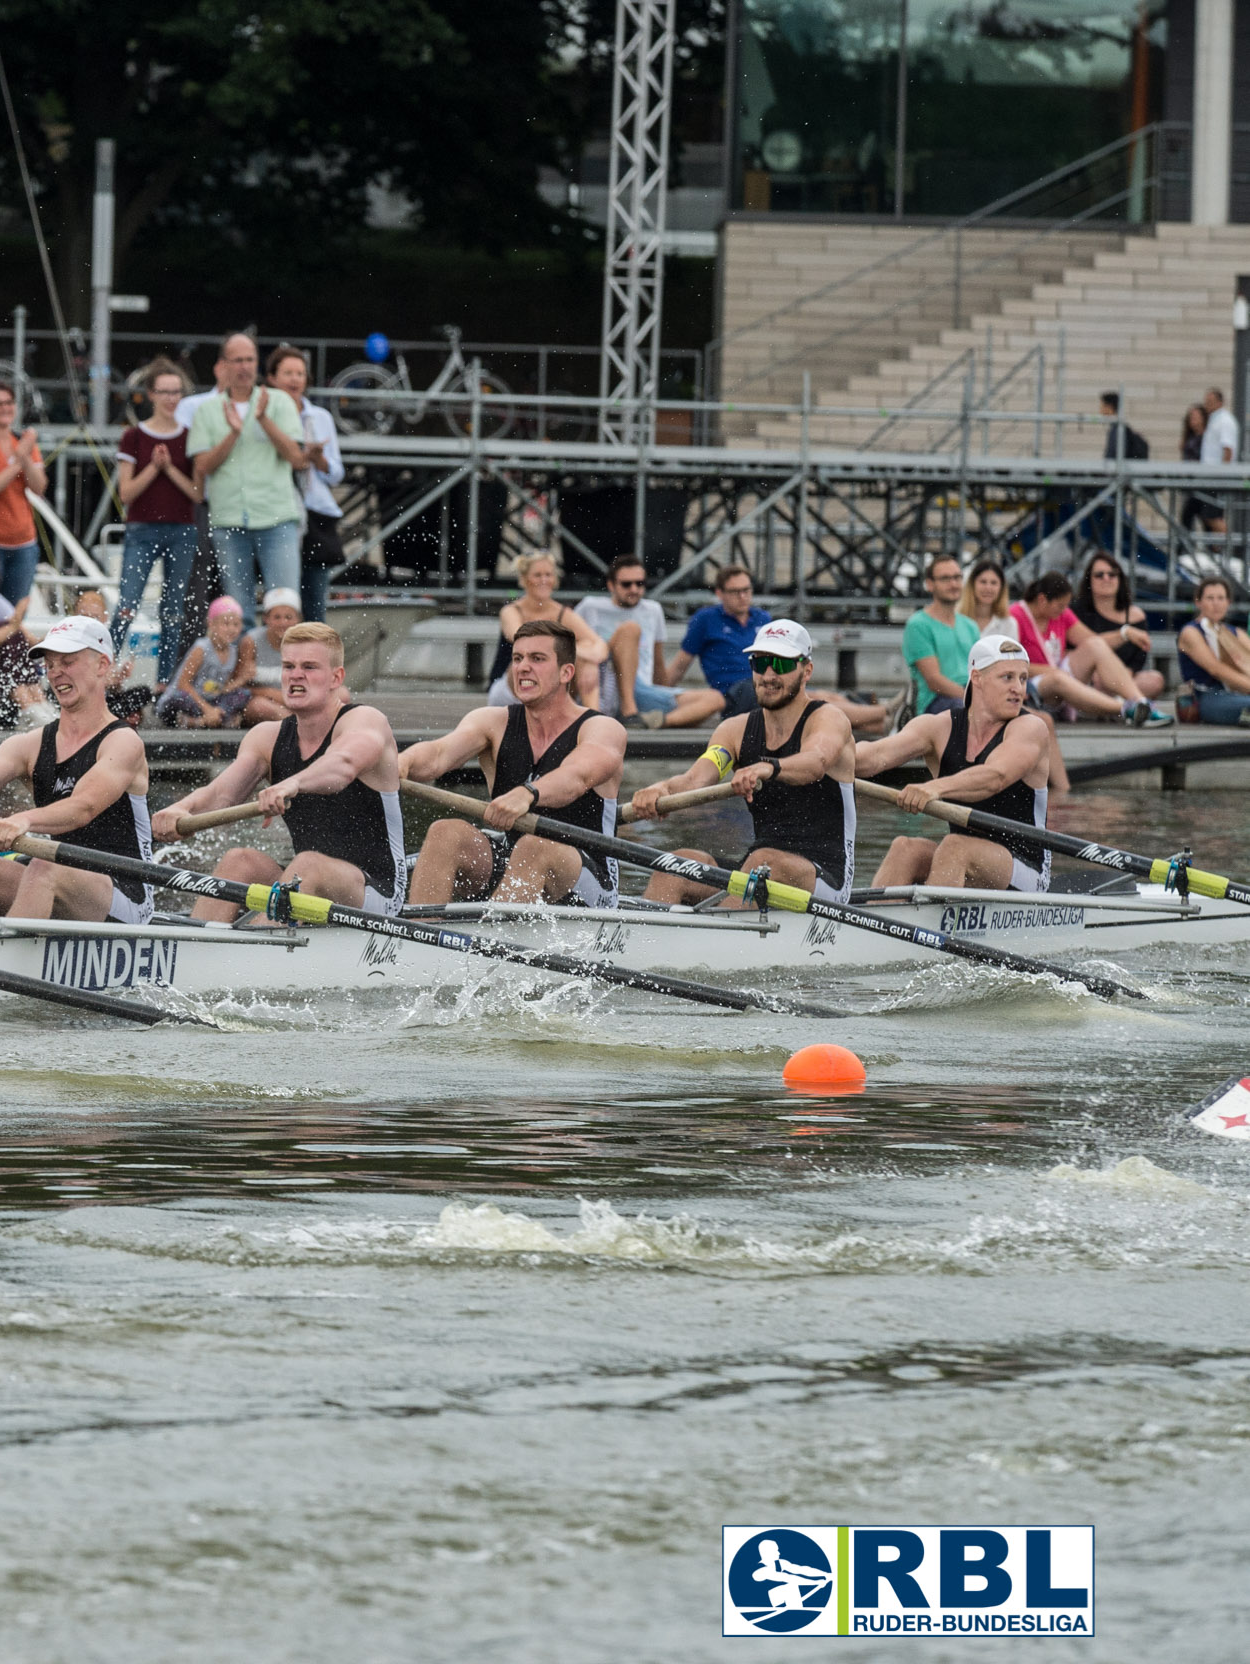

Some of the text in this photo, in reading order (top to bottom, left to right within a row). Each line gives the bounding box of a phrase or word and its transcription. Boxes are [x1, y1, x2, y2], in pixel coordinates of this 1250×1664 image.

[651, 852, 704, 880] Melitta
[166, 870, 220, 897] Melitta
[333, 912, 468, 949] STARK. SCHNELL. GUT. RBL
[811, 903, 941, 946] STARK. SCHNELL. GUT. RBL
[957, 905, 1085, 931] RBL RUDER-BUNDESLIGA
[44, 939, 175, 988] MINDEN
